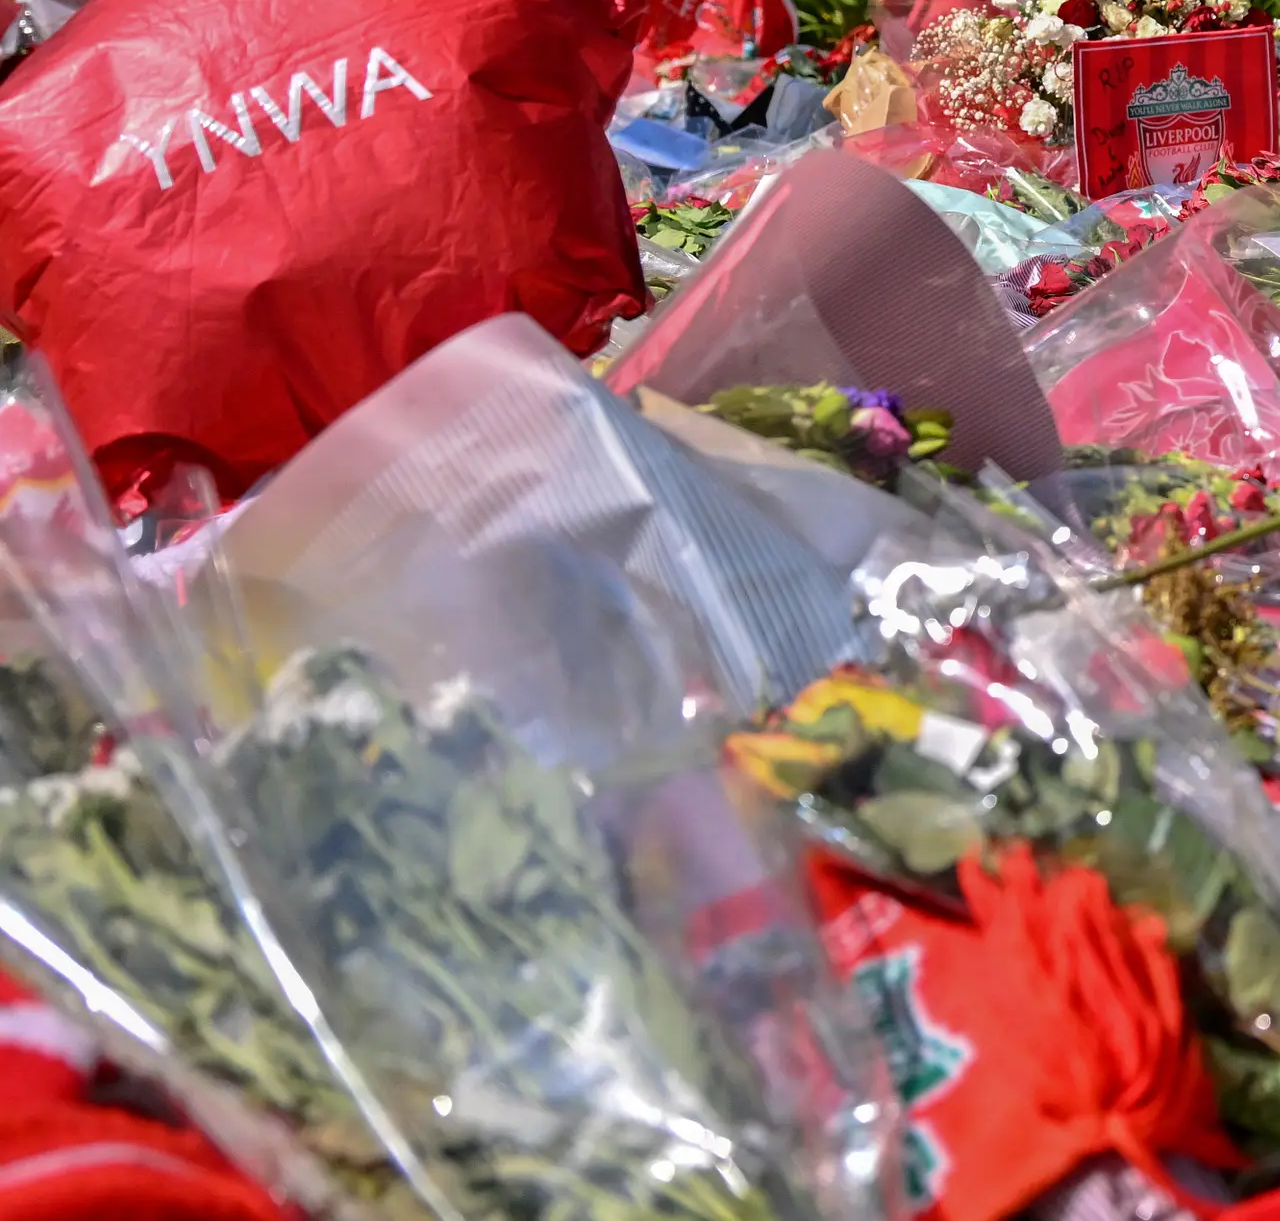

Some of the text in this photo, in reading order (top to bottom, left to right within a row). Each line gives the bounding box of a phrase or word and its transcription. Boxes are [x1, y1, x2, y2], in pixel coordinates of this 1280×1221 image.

[1098, 56, 1135, 93] RIP
[1155, 103, 1180, 115] NEVER
[1179, 101, 1203, 112] WALK
[1203, 98, 1229, 110] ALONE
[119, 46, 433, 191] YNWA
[1145, 125, 1220, 148] LIVERPOOL
[1147, 142, 1217, 159] FOOTBALL CLUB
